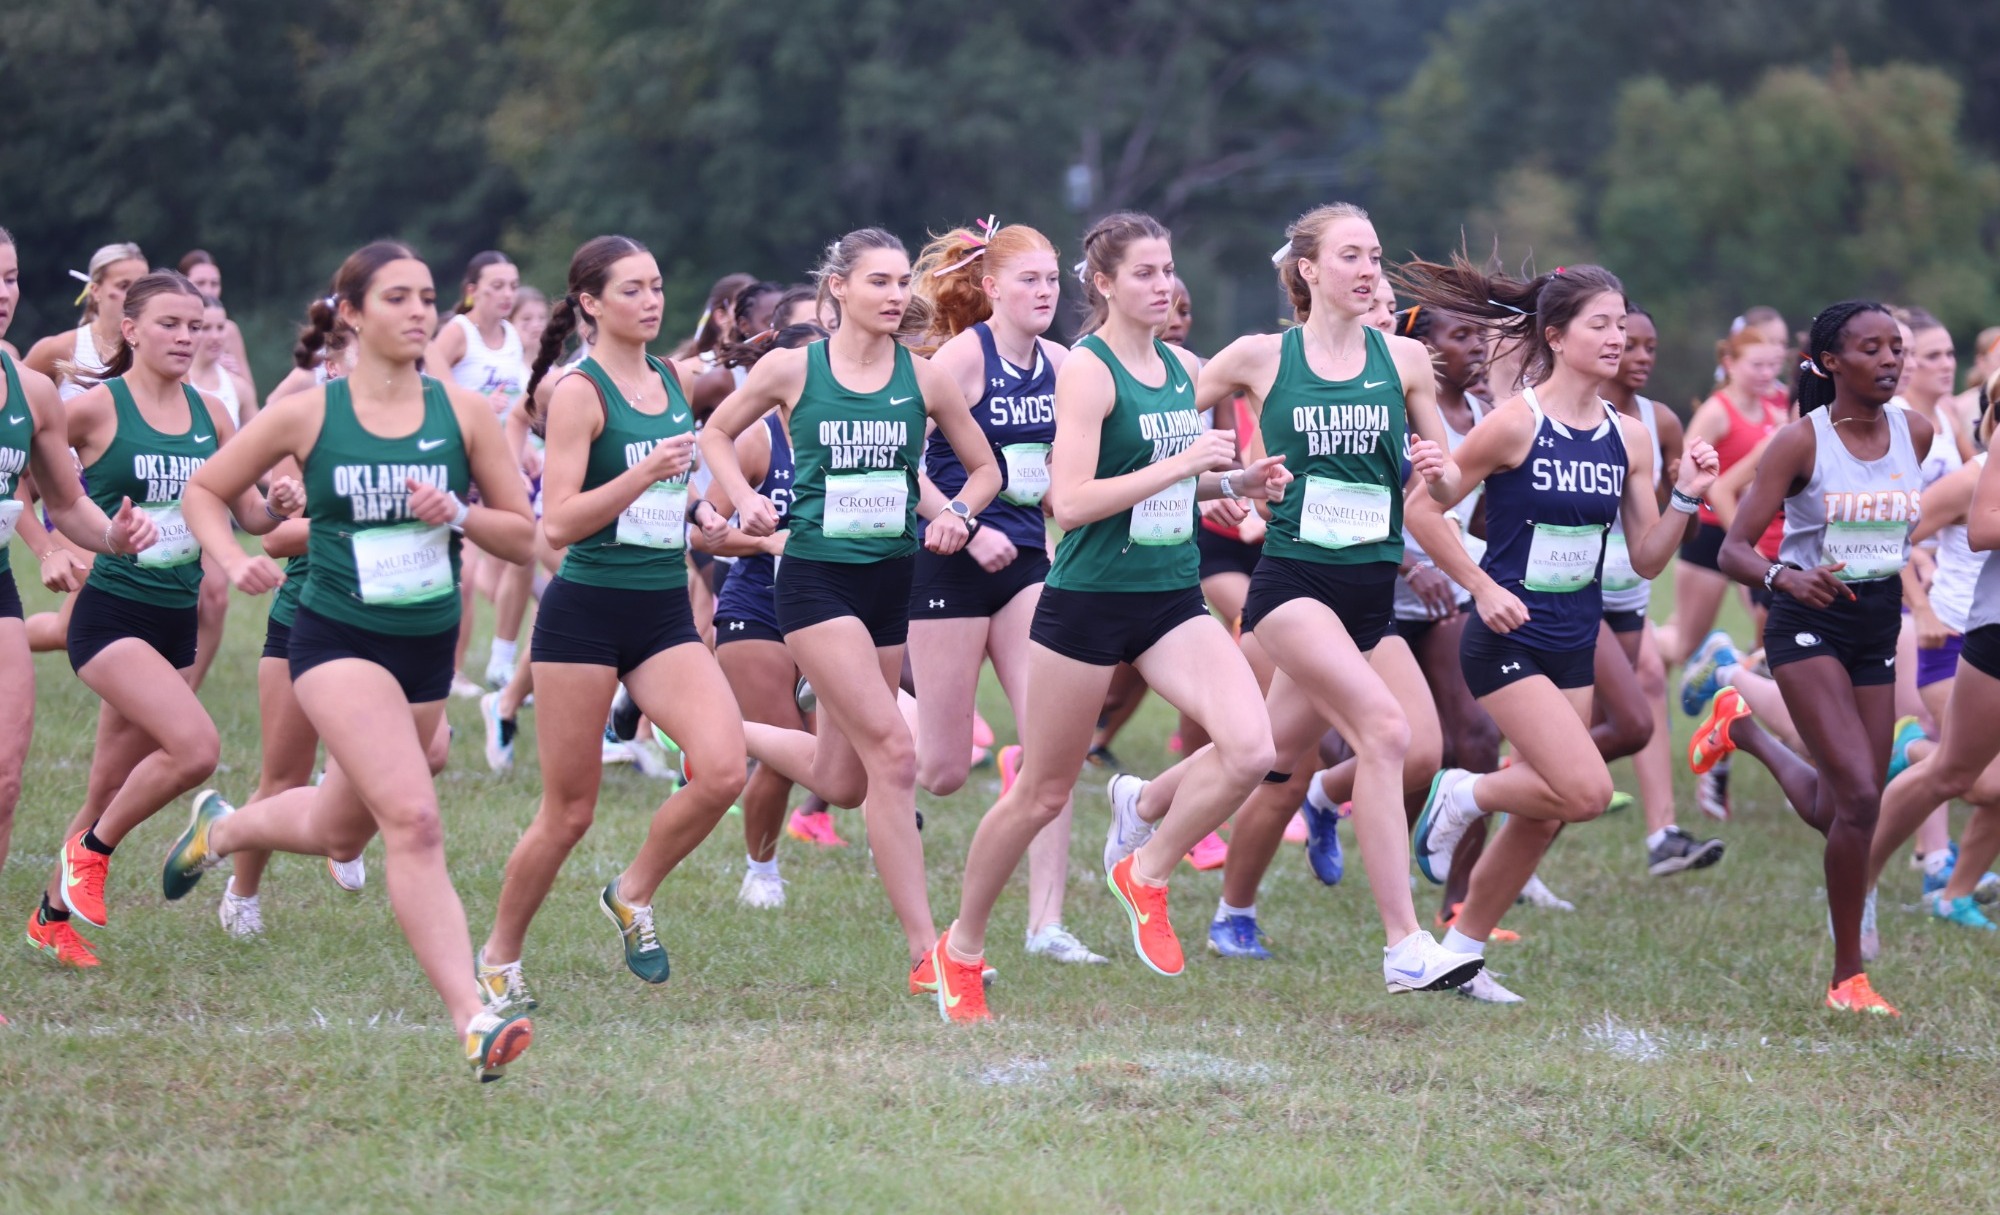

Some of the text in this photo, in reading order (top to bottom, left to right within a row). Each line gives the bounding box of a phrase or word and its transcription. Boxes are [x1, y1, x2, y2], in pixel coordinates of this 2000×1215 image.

[1293, 405, 1389, 432] OKLAHOMA
[819, 421, 907, 445] OKLAHOMA
[1307, 430, 1380, 456] BAPTIST
[830, 445, 898, 469] BAPTIST
[1149, 434, 1199, 463] BAPTIS
[134, 454, 206, 480] OKLAHO
[1017, 468, 1045, 477] NELSON
[1532, 458, 1624, 497] SWOSU
[146, 479, 187, 502] BAPT
[839, 496, 895, 508] CROUCH
[351, 493, 414, 521] BAPTI
[626, 506, 684, 522] ETHERIDGE
[1143, 498, 1188, 511] HENDRIX
[1307, 503, 1385, 523] CONNELL-LYDA
[1824, 489, 1921, 523] TIGERS
[375, 546, 438, 572] MURPHY
[1549, 550, 1589, 562] RADKE
[1828, 543, 1899, 555] W. KIPSANG
